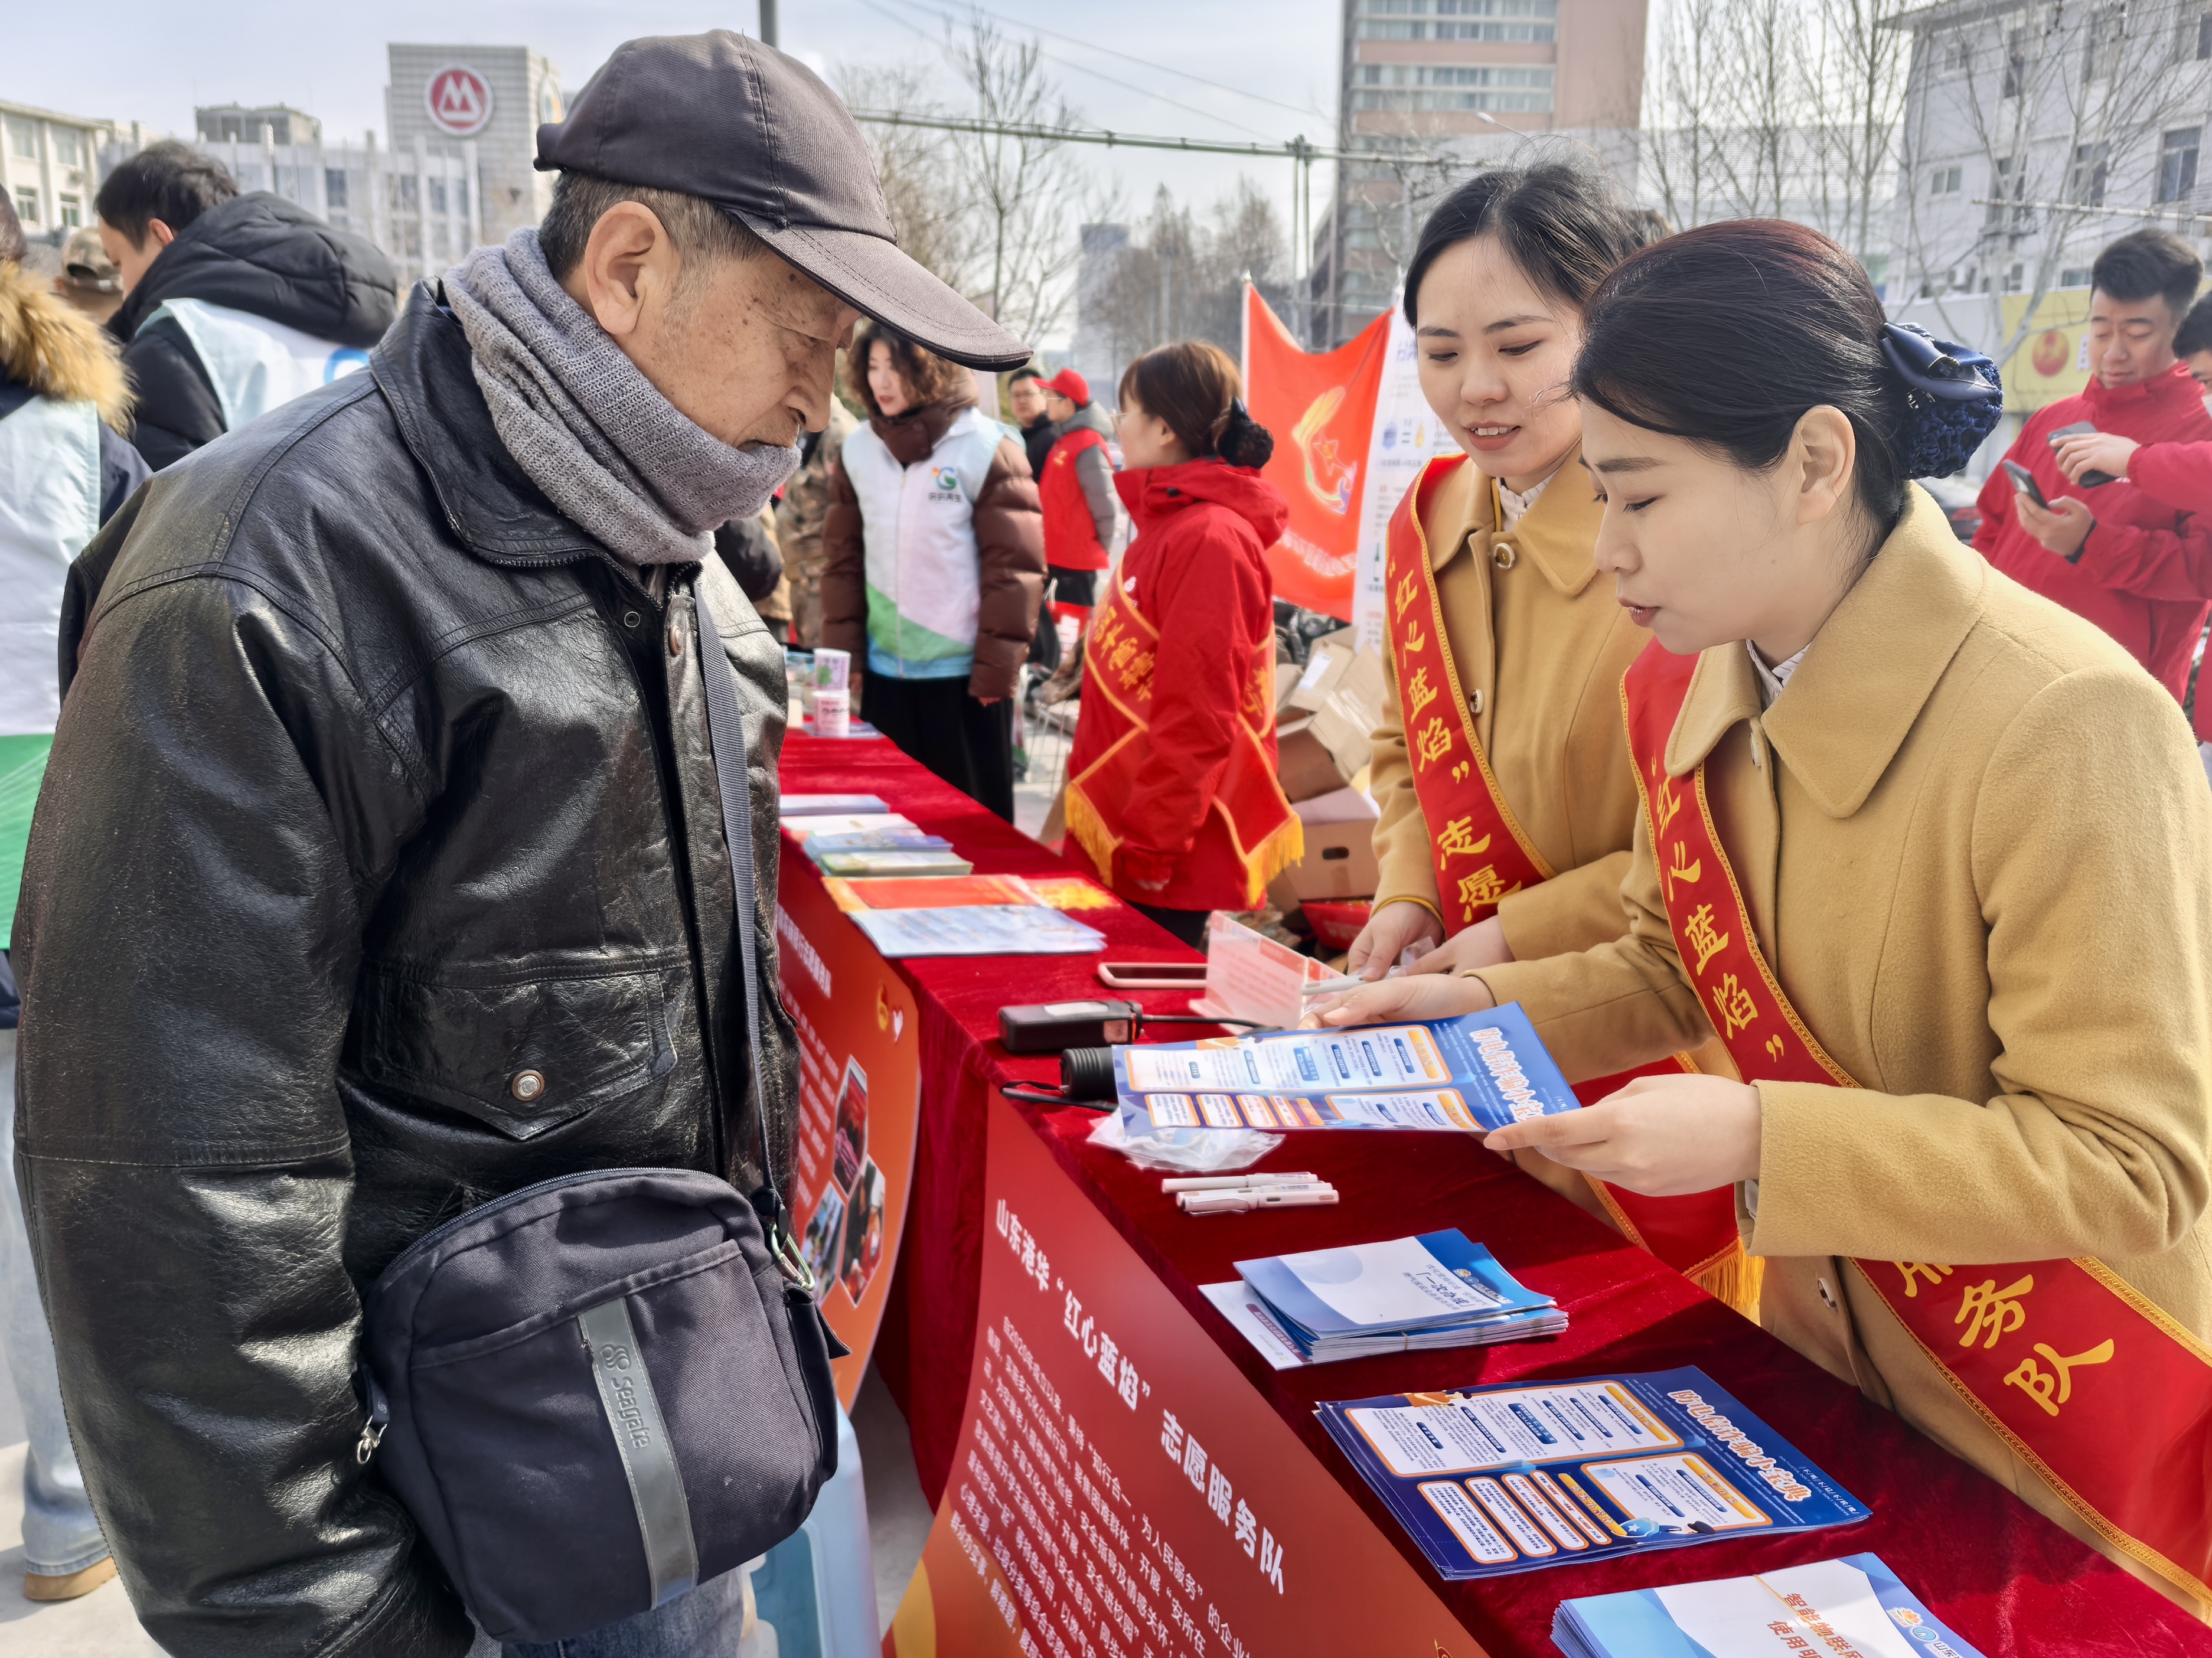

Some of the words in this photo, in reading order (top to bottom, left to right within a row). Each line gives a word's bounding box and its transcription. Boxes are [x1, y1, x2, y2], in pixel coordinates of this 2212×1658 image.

[1472, 1029, 1544, 1121] 防电信诈骗小宝
[612, 1376, 650, 1449] Seagate
[1668, 1391, 1812, 1500] 防电信诈骗小宝典
